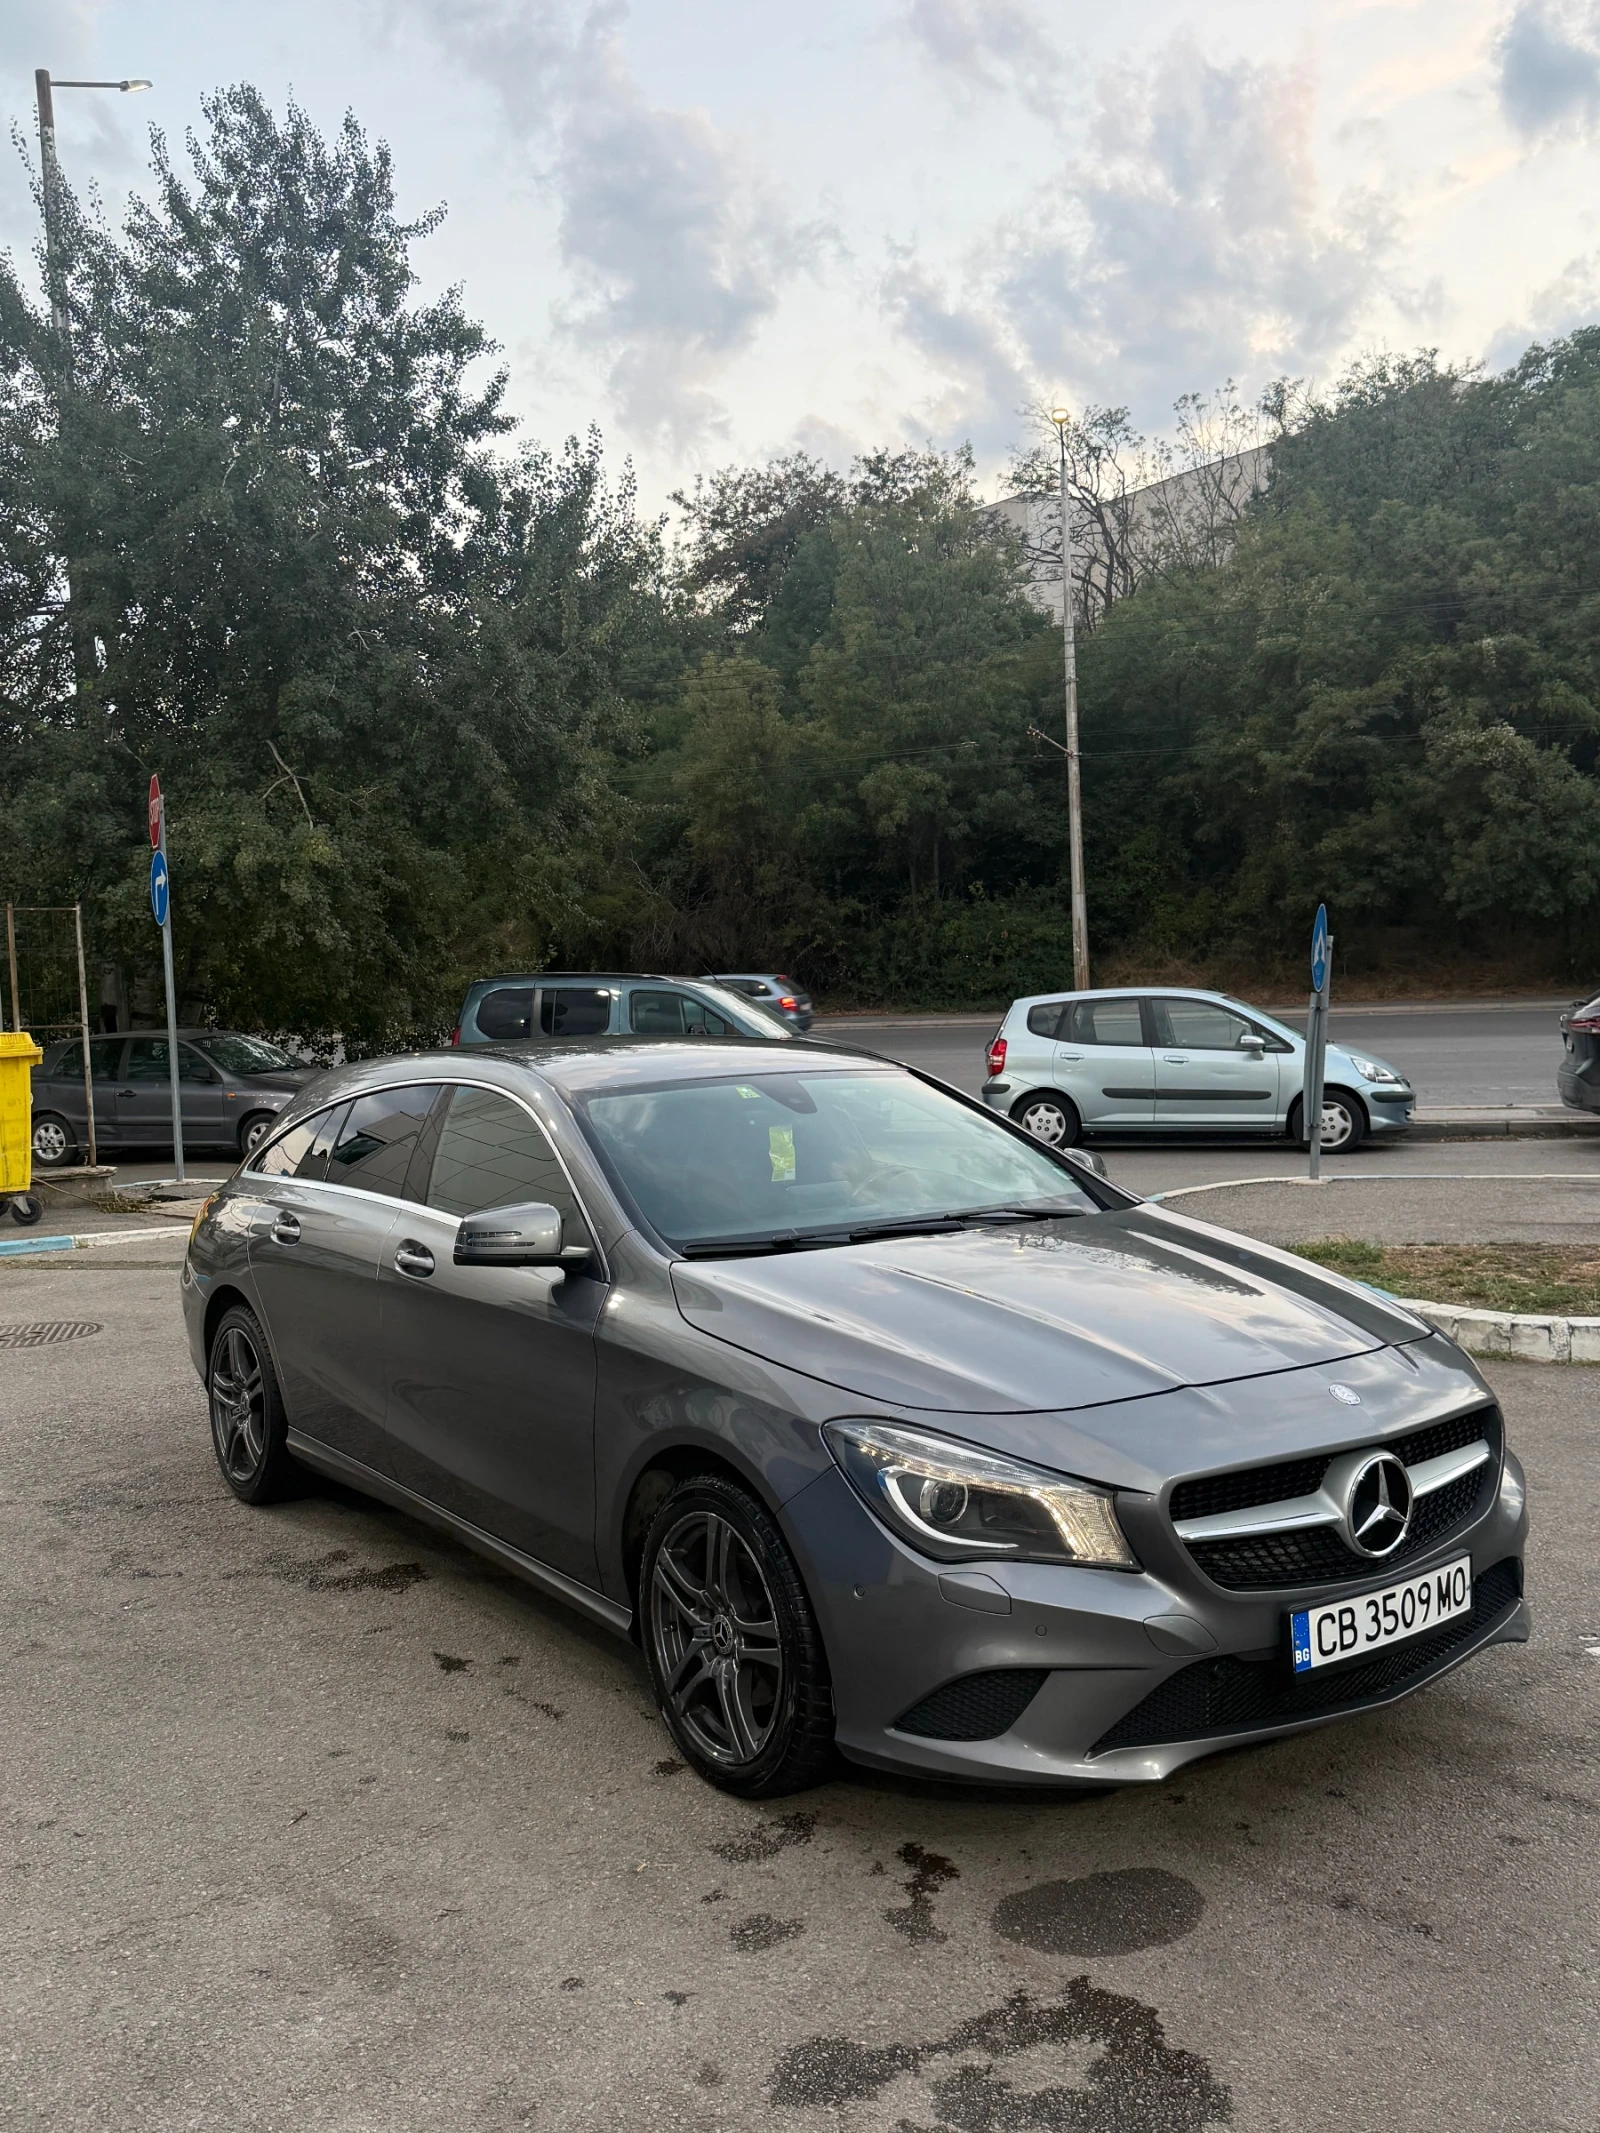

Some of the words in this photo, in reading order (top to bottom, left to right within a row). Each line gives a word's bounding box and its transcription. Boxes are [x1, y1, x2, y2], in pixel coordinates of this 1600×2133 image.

[1316, 1606, 1358, 1657] CB
[1365, 1581, 1431, 1642] 3509
[1437, 1566, 1466, 1617] MO
[1295, 1648, 1310, 1664] BG
